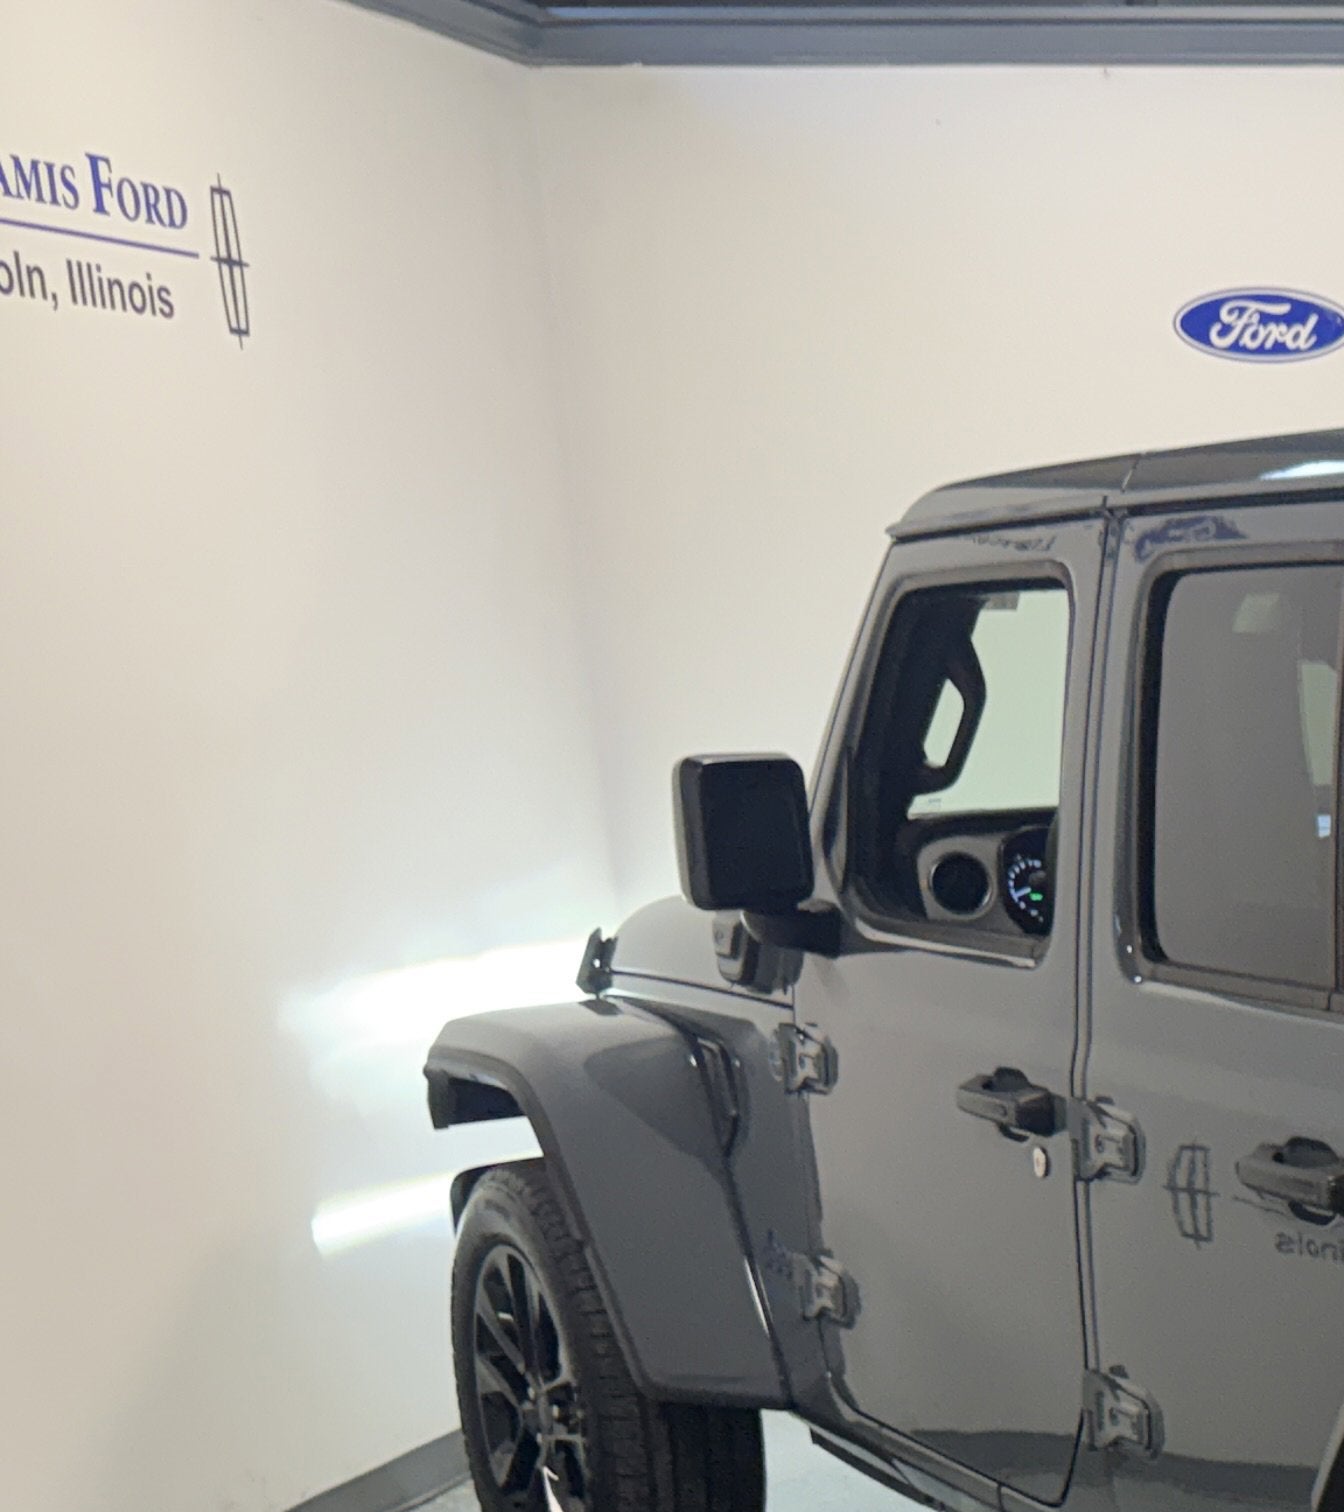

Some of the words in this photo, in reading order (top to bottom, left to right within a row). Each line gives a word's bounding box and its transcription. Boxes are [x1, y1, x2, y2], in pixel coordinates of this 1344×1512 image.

[85, 151, 189, 230] FORD
[66, 258, 175, 320] Illinois
[1208, 299, 1319, 350] Ford
